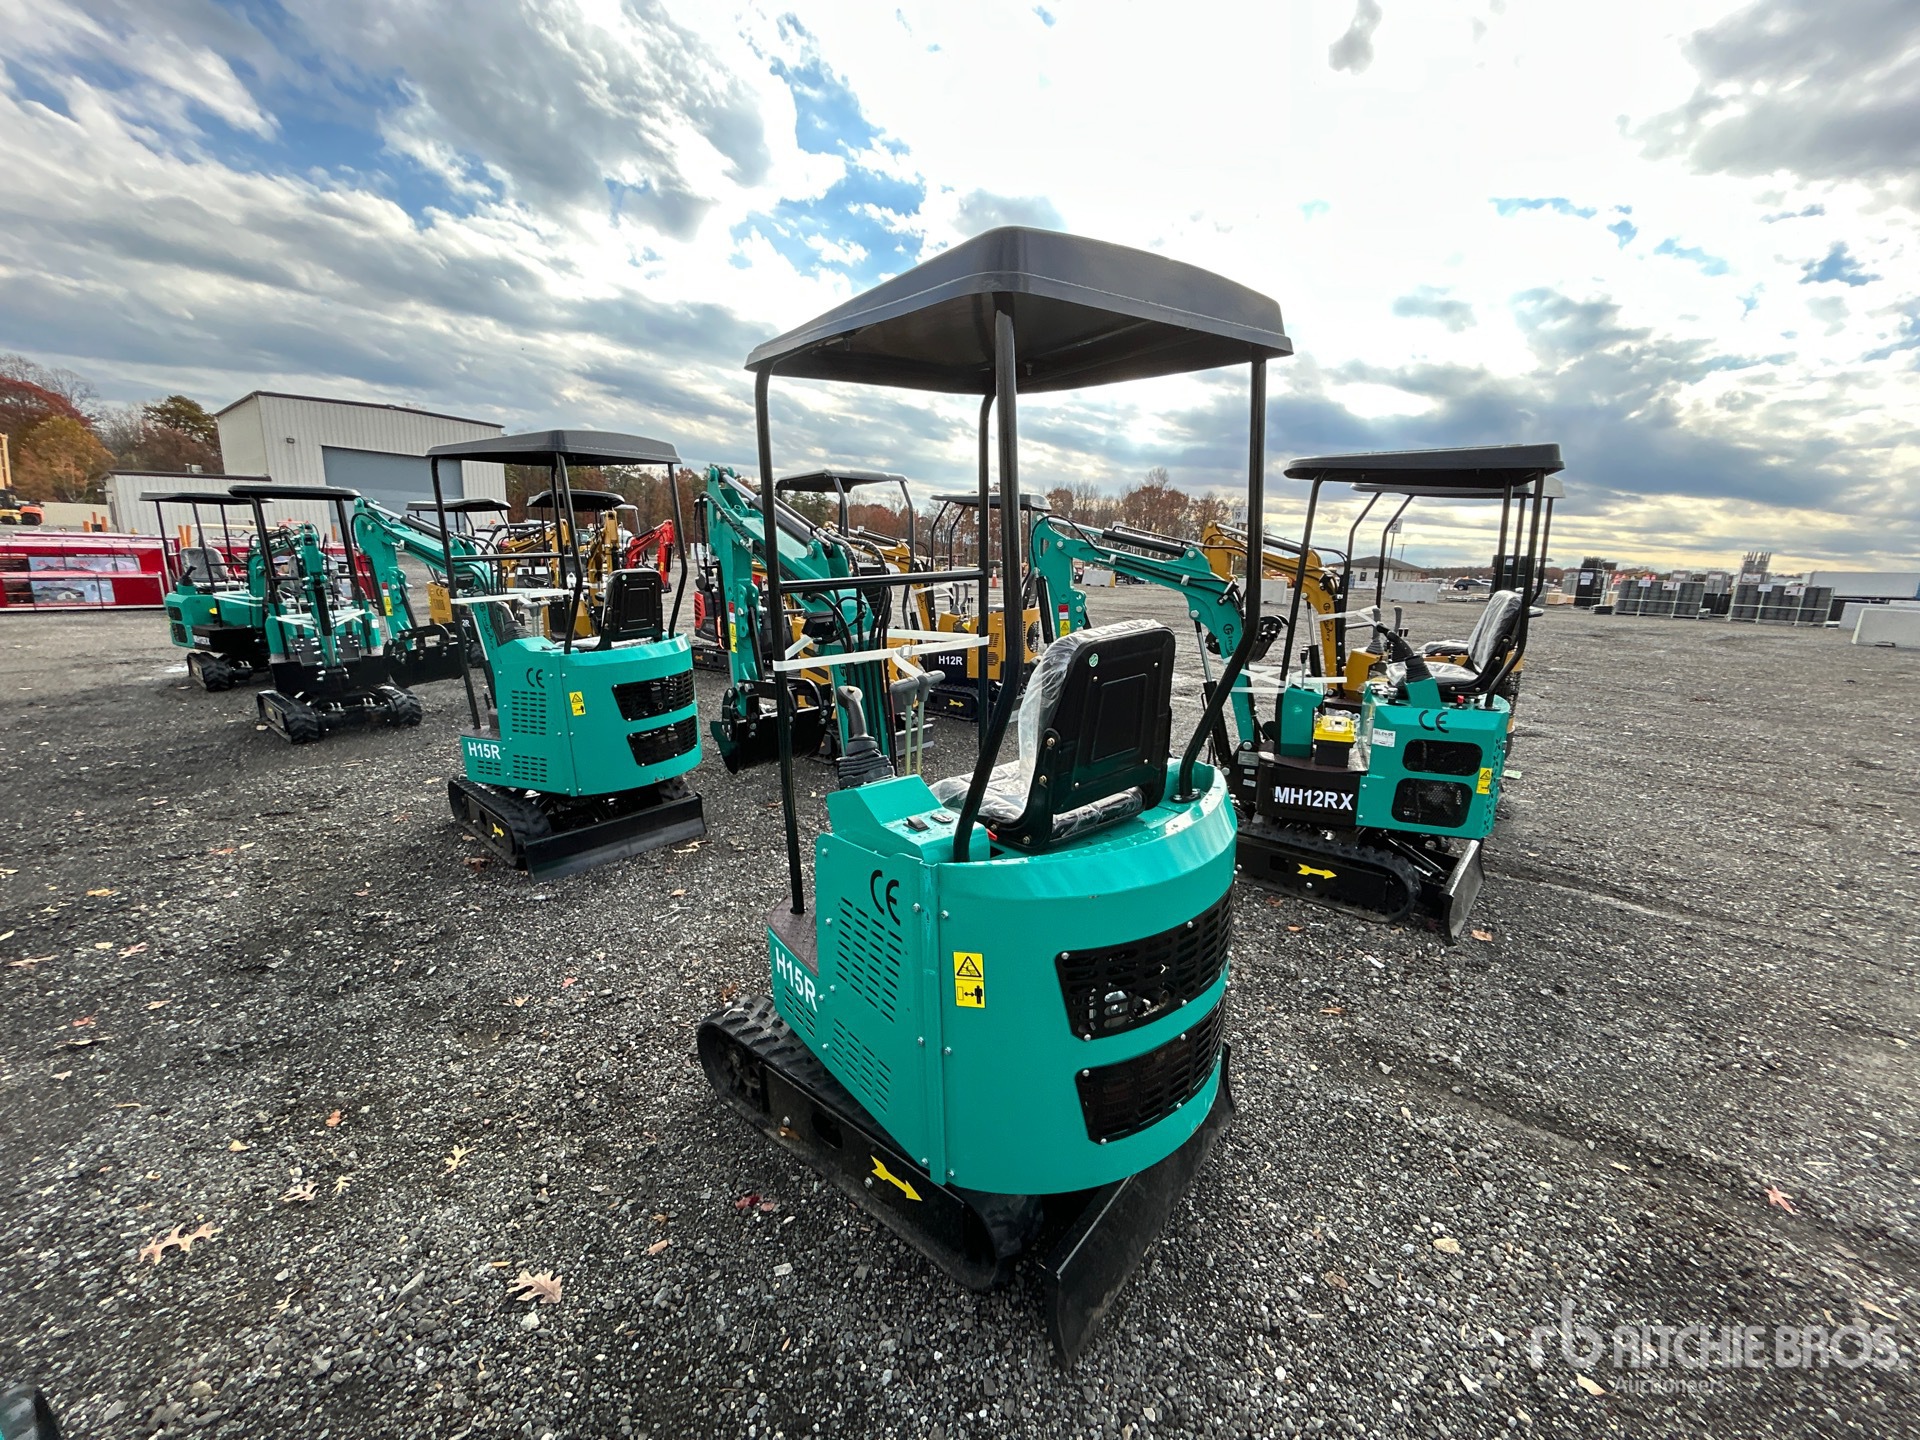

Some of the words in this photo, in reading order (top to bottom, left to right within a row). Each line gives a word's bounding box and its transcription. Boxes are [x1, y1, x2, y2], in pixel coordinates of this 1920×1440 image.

[938, 655, 963, 666] H12R
[526, 667, 545, 690] CE
[1418, 709, 1450, 734] CE
[467, 741, 502, 760] H15R
[1274, 785, 1354, 811] MH12RX
[869, 869, 901, 927] CE
[775, 946, 818, 1013] H15R
